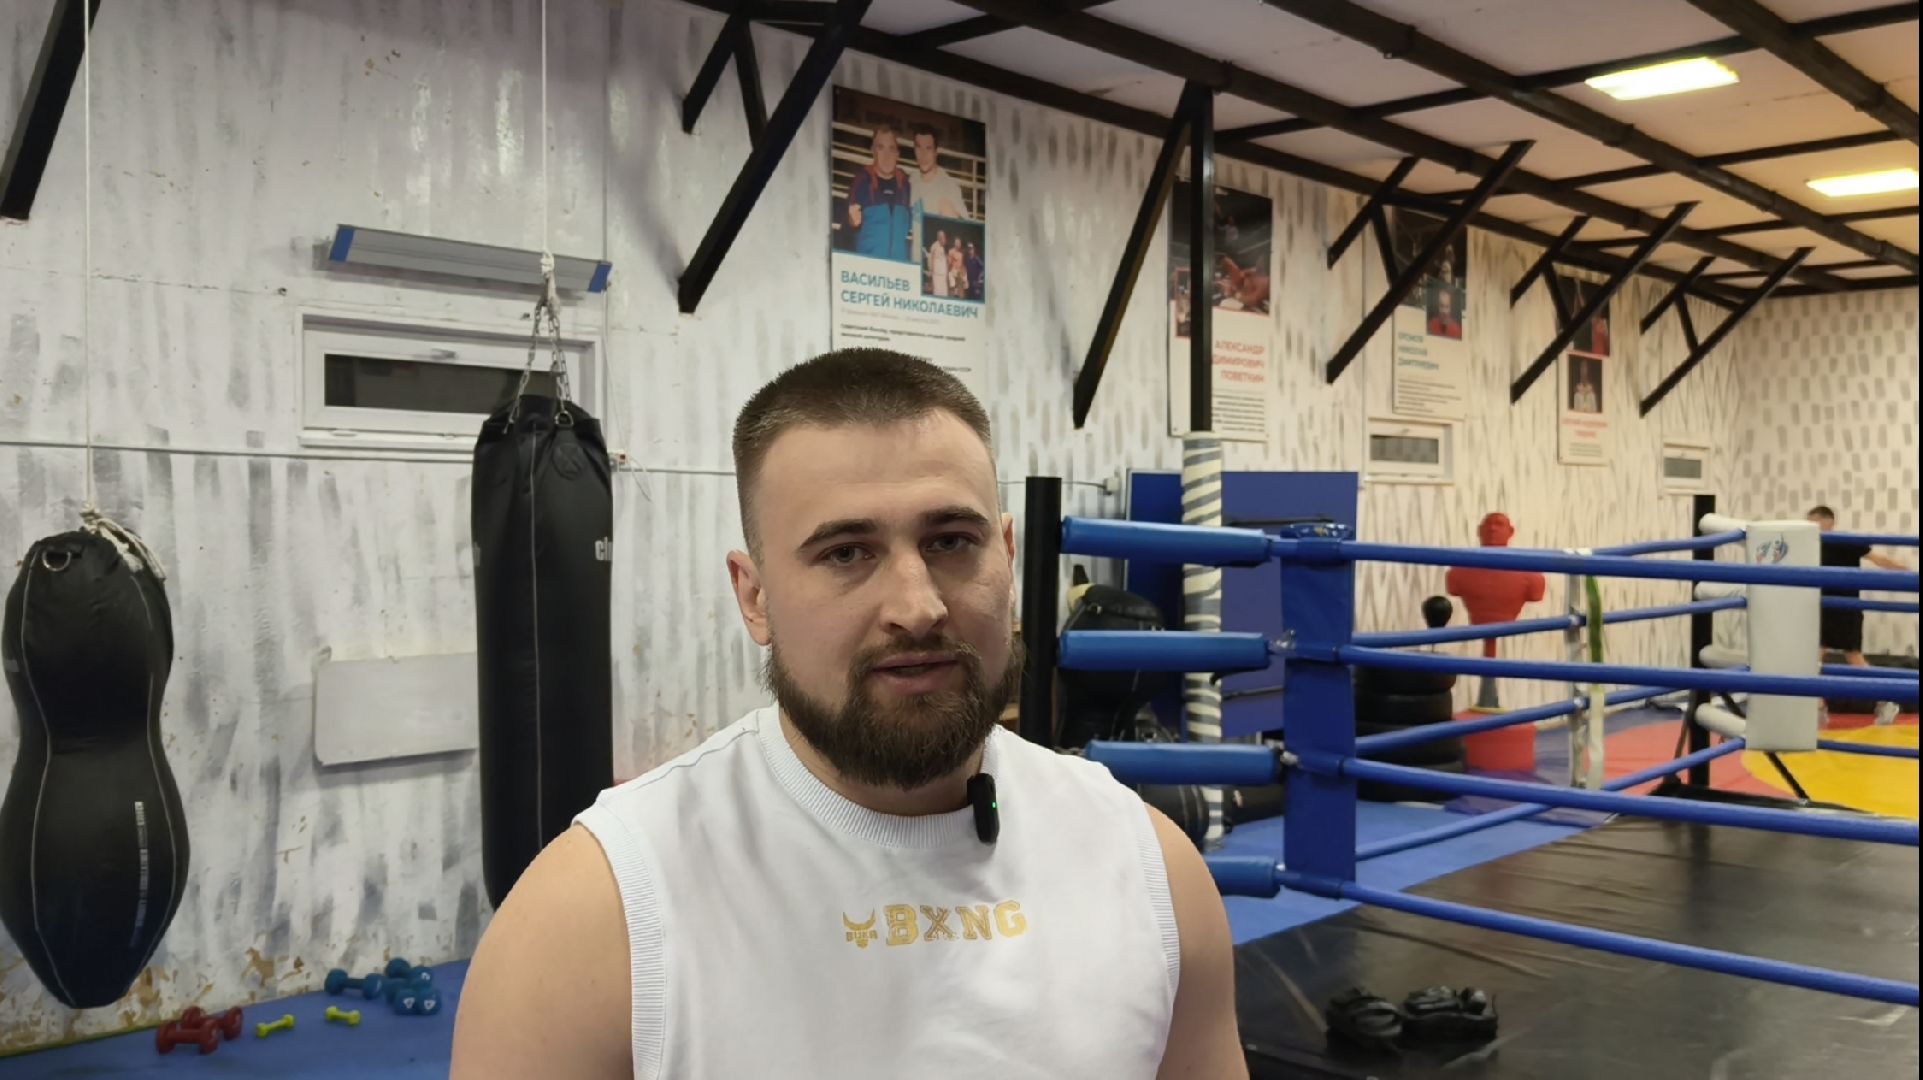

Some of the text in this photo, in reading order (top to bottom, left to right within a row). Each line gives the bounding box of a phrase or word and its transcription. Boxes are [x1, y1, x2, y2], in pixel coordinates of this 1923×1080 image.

[841, 270, 910, 292] ВАСИЛЬЕВ
[840, 289, 891, 308] СЕРГЕЙ
[893, 298, 978, 319] НИКОЛАЕВИЧ
[883, 900, 1027, 947] BXNG
